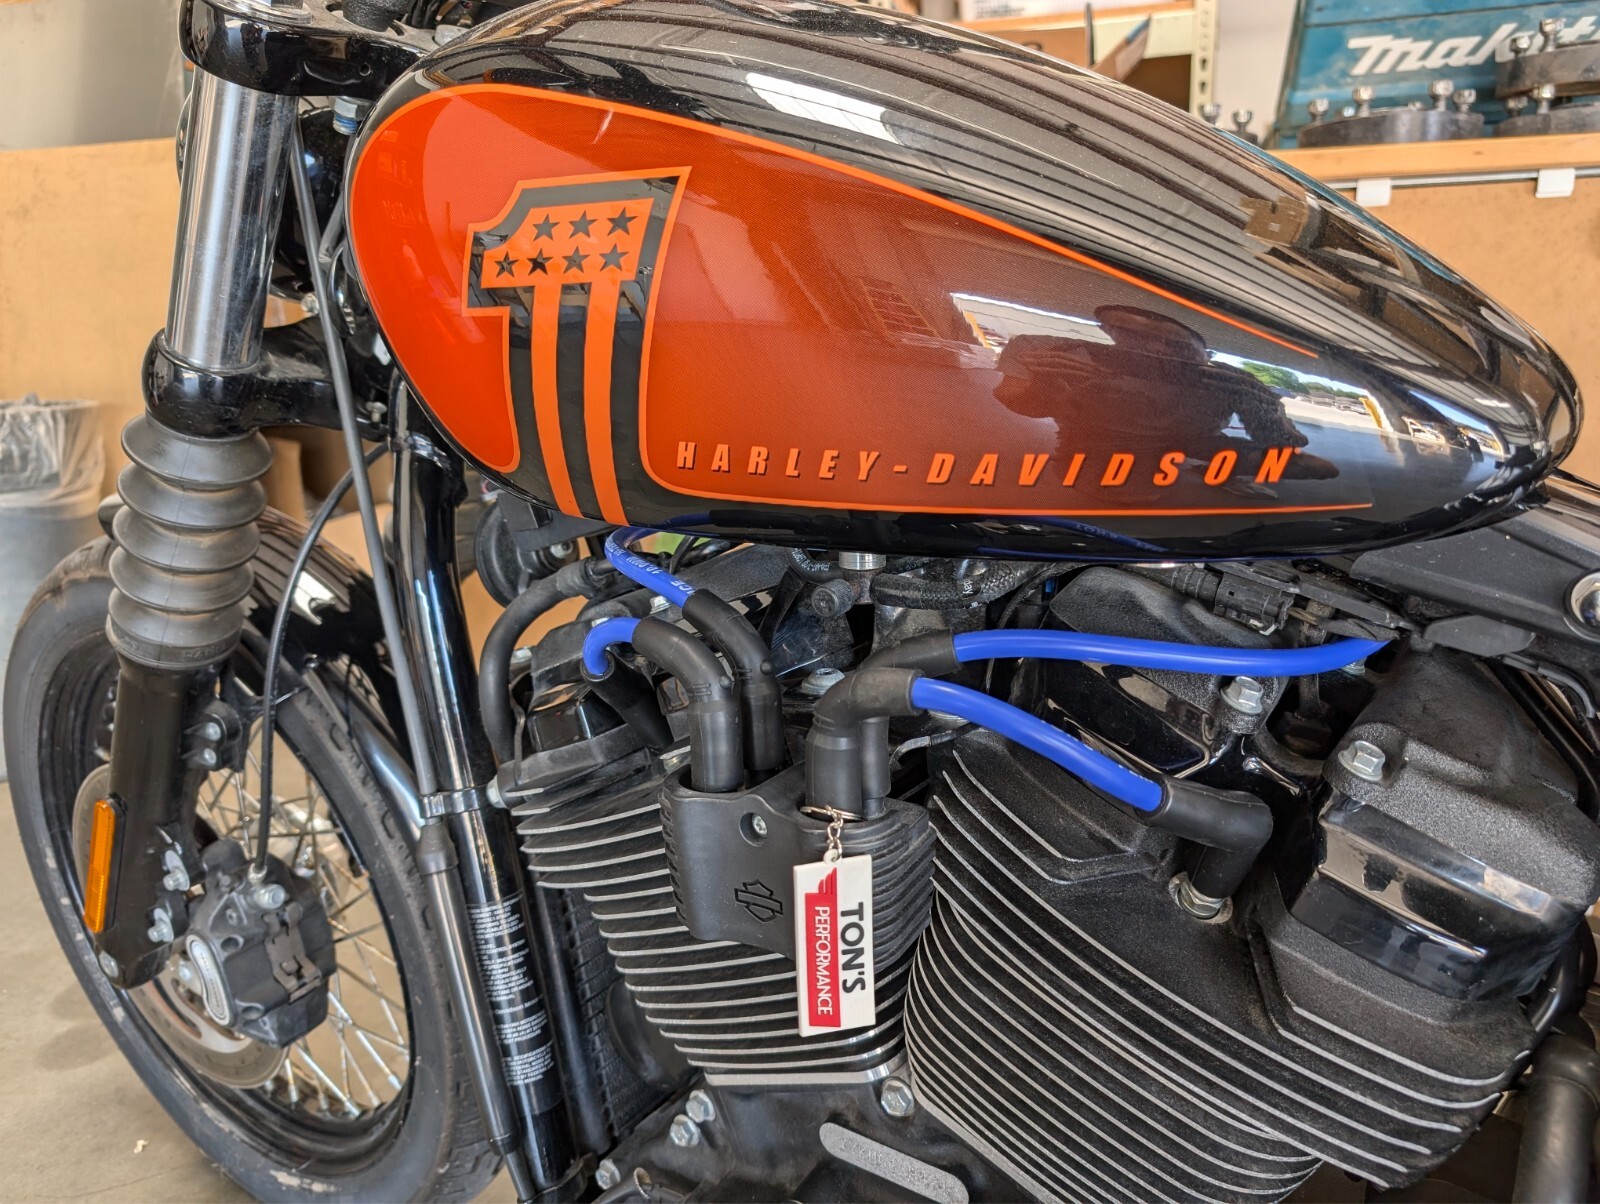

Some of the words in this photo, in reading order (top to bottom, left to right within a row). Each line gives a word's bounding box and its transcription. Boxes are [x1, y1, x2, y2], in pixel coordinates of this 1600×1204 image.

[676, 440, 1293, 488] HARLEY-DAVIDSON
[815, 906, 833, 1016] PERFORMANCE
[840, 902, 866, 994] TON'S
